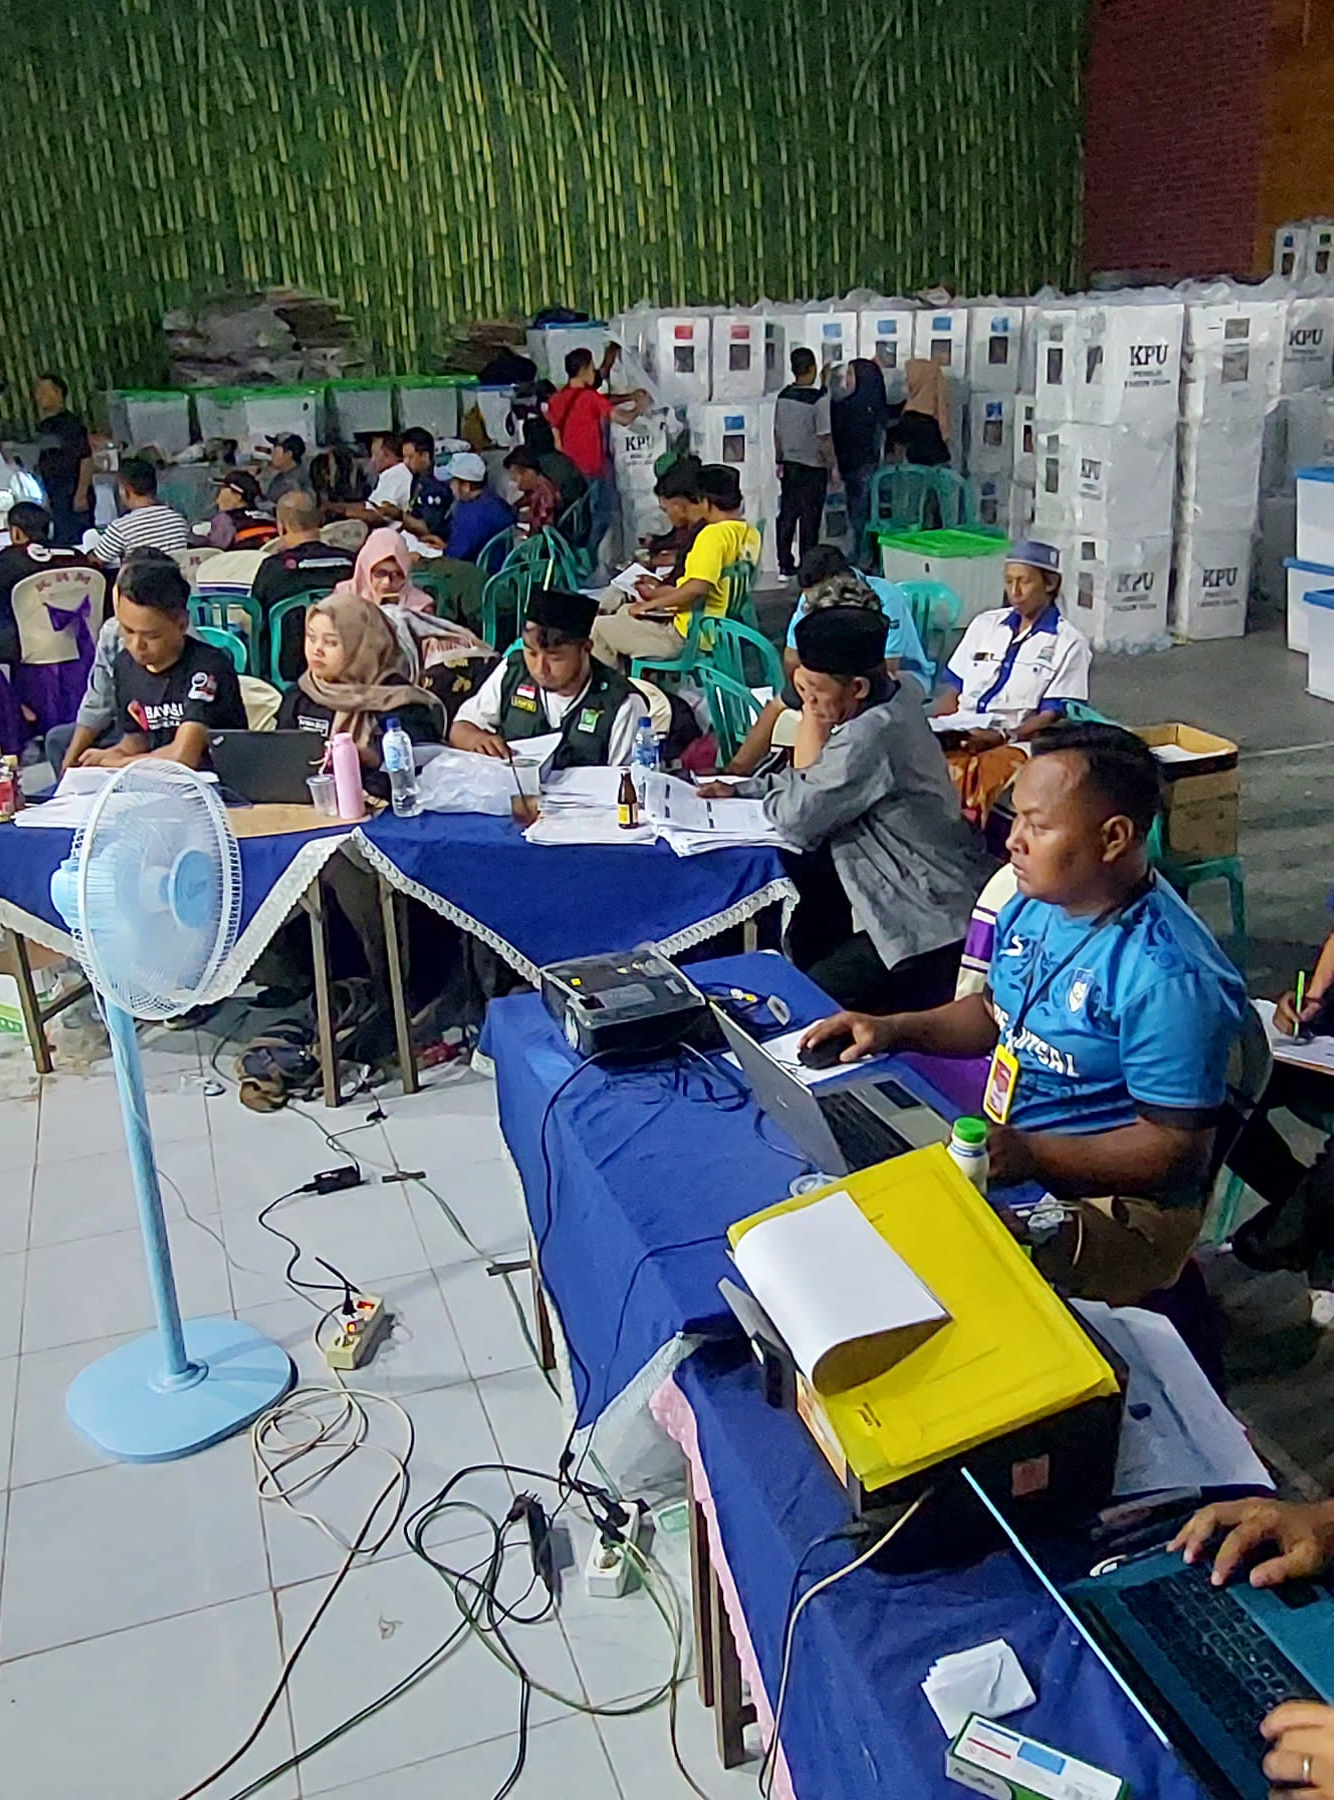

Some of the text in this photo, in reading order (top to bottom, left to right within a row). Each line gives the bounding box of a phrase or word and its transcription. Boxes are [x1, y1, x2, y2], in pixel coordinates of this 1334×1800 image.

[1289, 329, 1324, 347] KPU
[1129, 344, 1169, 366] KPU
[1117, 571, 1155, 593] KPU
[1202, 567, 1239, 588] KPU
